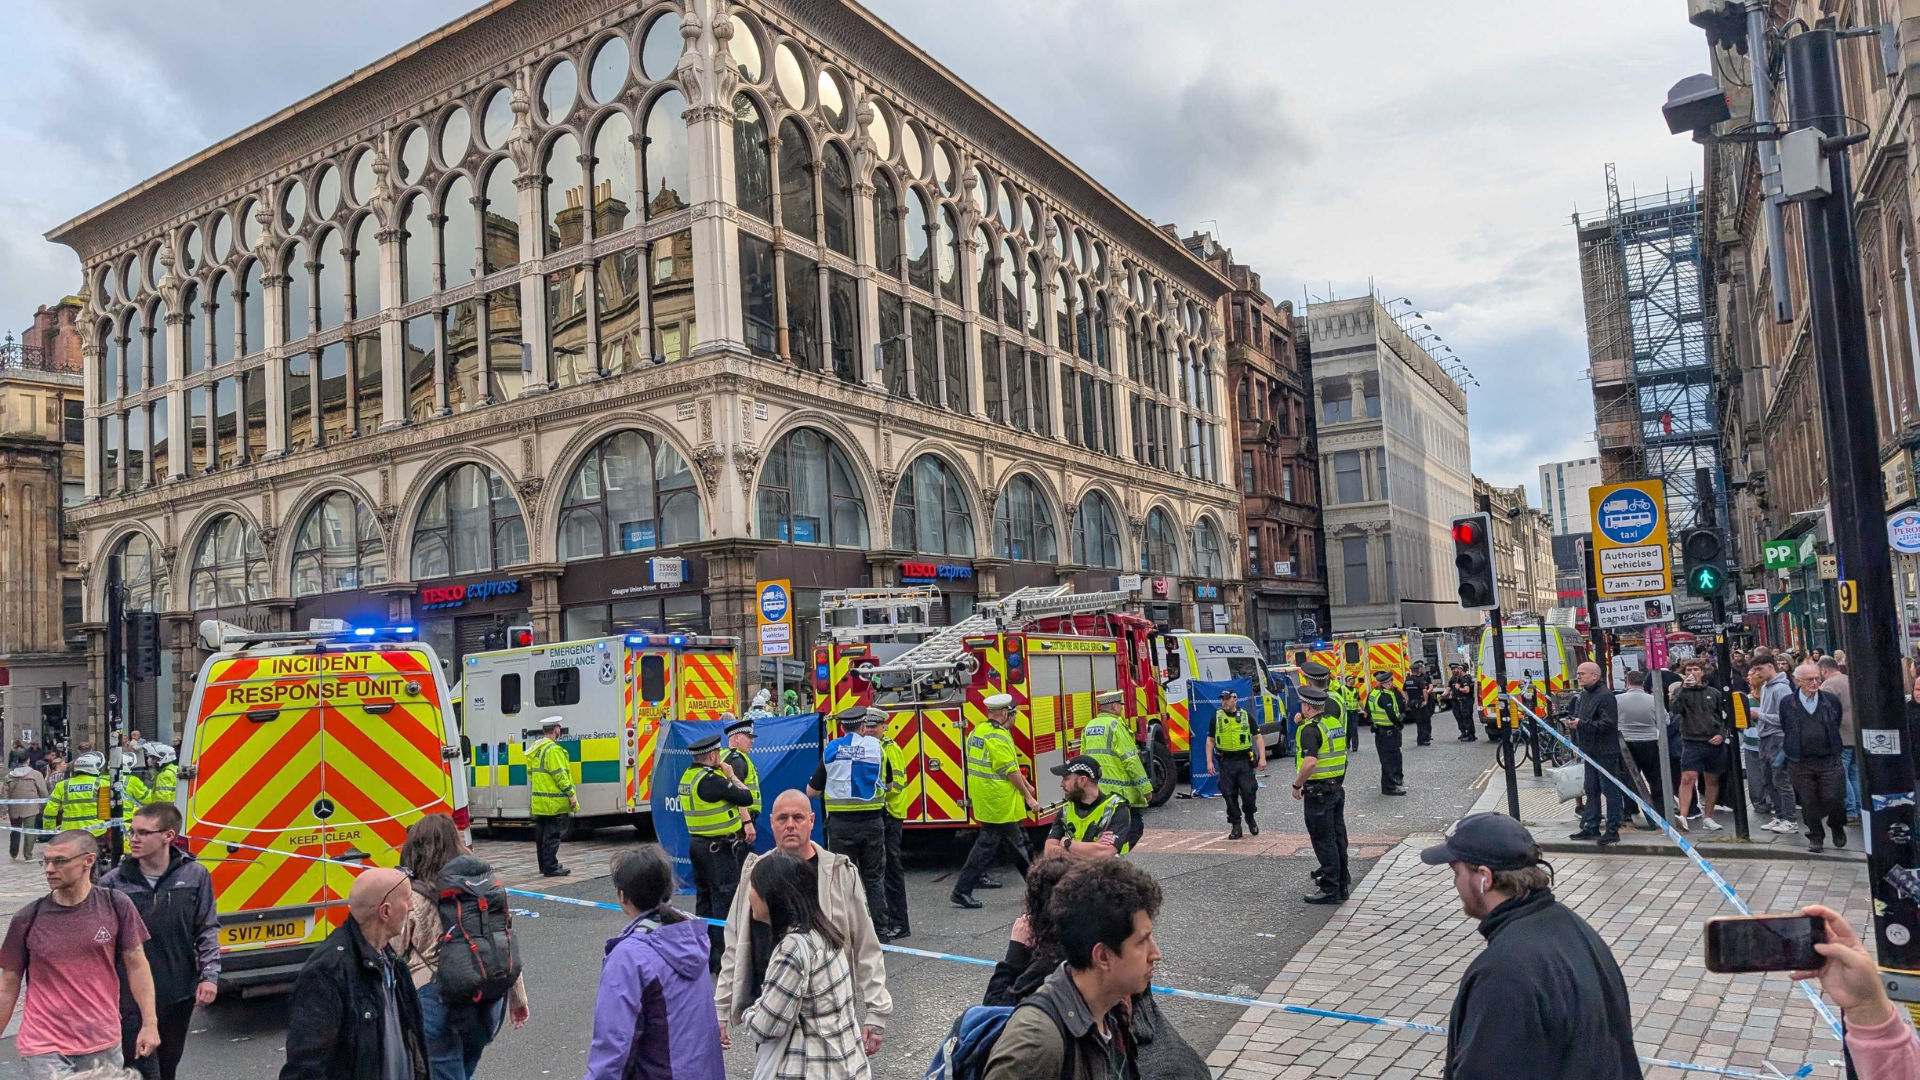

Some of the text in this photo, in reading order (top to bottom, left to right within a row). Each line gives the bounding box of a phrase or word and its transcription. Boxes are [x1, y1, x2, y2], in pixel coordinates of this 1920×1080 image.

[1894, 526, 1920, 535] PERO
[1605, 550, 1658, 560] Authorised
[1612, 560, 1652, 569] vehicles
[902, 562, 972, 583] TESCO express
[421, 579, 519, 603] TESCO express
[1840, 582, 1852, 612] 9
[1600, 604, 1640, 614] Bus lane
[550, 644, 595, 657] EMERGENCY
[1080, 642, 1090, 651] RESCUE
[1208, 645, 1245, 654] POLICE
[272, 655, 372, 674] INCIDENT
[550, 656, 595, 669] AMBULANCE
[230, 680, 403, 704] RESPONSE UNIT
[639, 700, 730, 716] AMBULANCE AMBAILEANS
[559, 733, 592, 741] Ambulance
[1086, 727, 1104, 735] POLICE
[69, 784, 92, 792] POLICE
[665, 797, 682, 812] POLI
[290, 830, 361, 845] KEEP CLEAR
[228, 923, 295, 941] SV17 MDO
